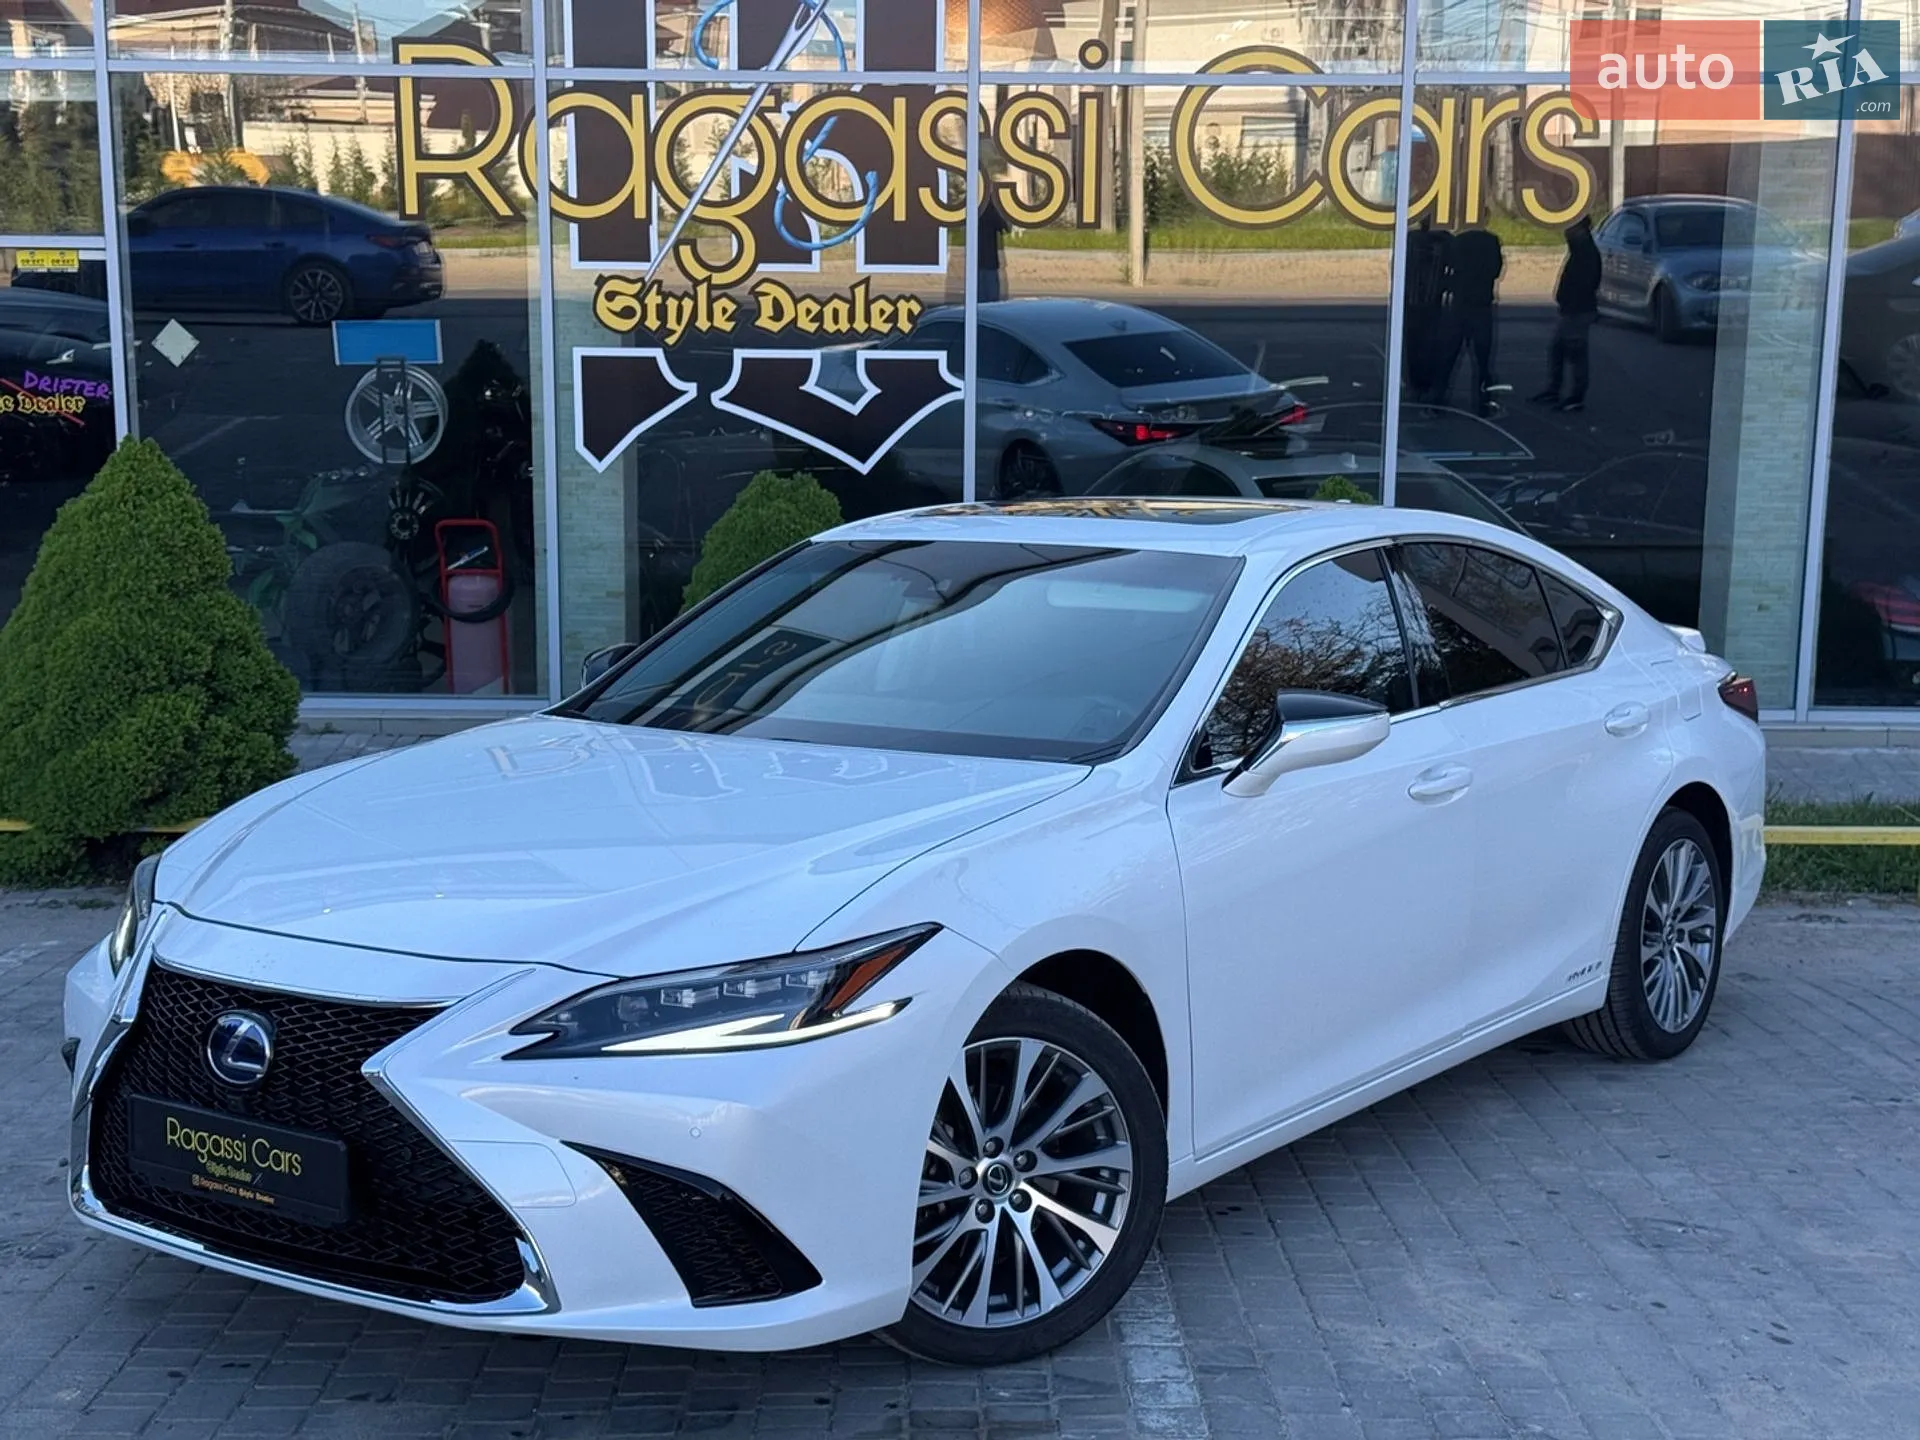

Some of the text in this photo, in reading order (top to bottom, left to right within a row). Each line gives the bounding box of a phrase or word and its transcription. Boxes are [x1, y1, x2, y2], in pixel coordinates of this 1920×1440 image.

[394, 37, 1598, 286] Ragassi Cars
[594, 274, 924, 347] Style Dealer
[0, 391, 86, 414] e Dealer
[24, 370, 110, 400] DRIFTER
[166, 1117, 302, 1177] Ragassi Cars
